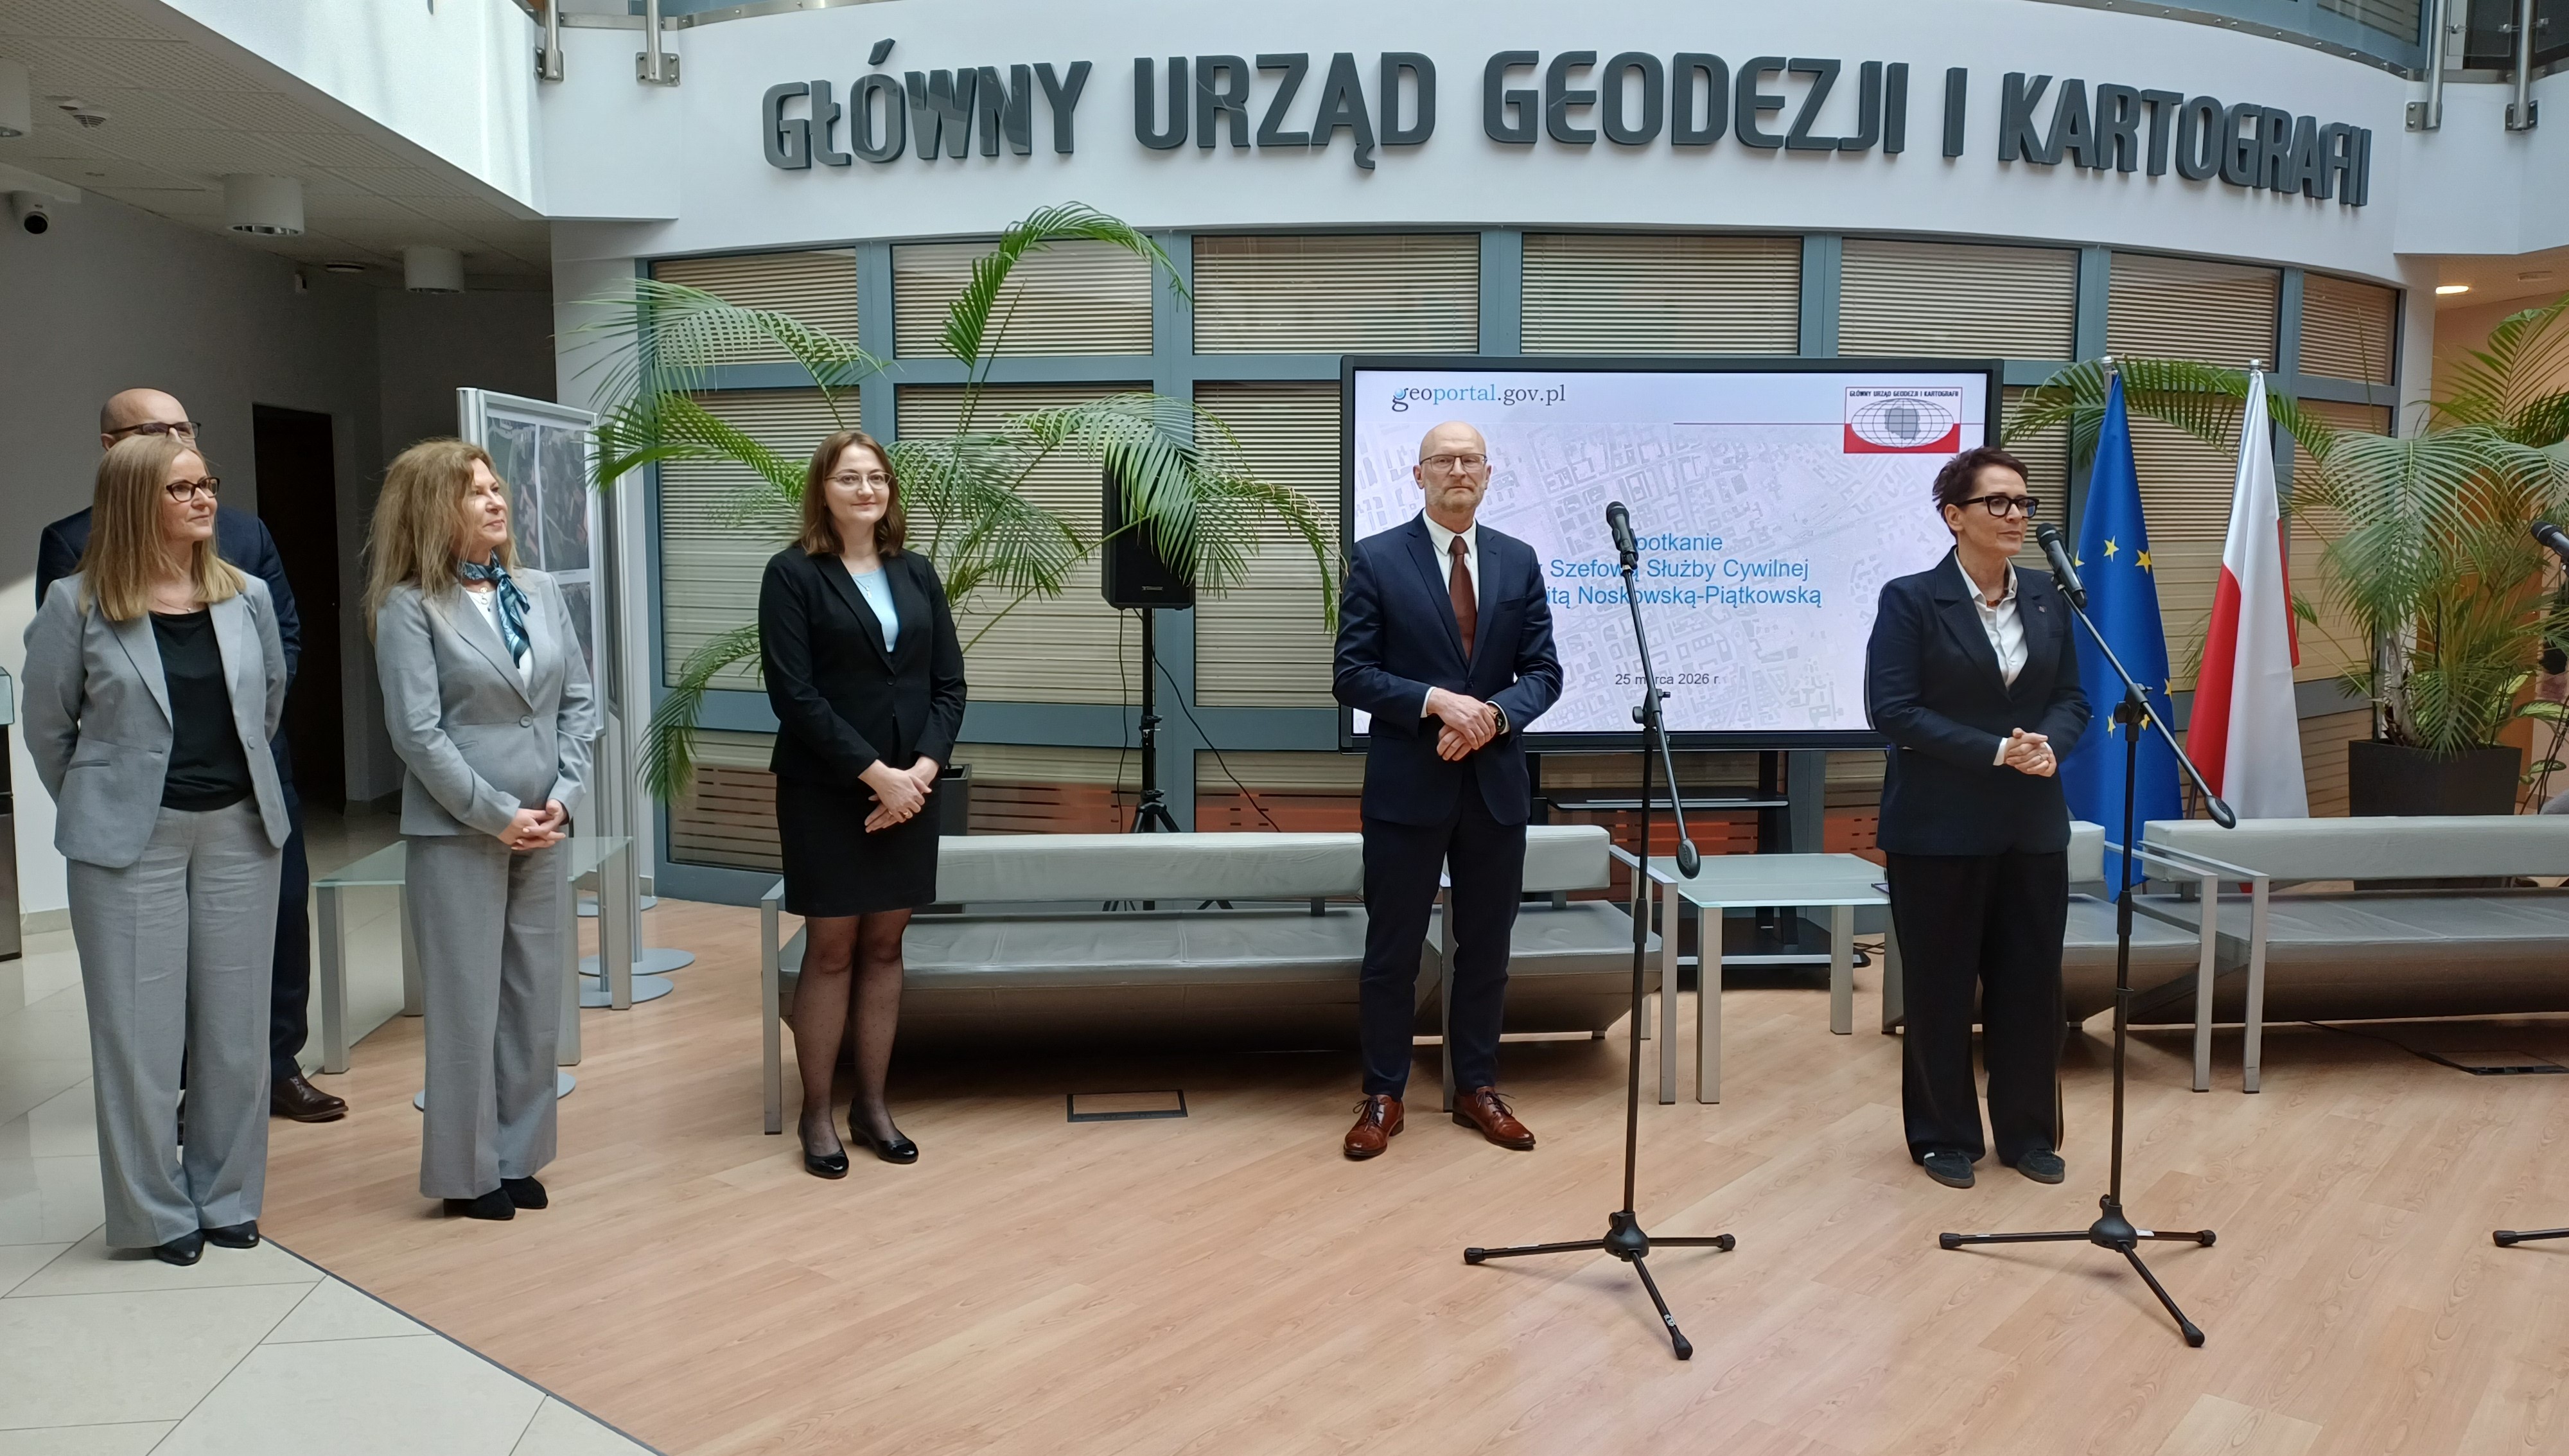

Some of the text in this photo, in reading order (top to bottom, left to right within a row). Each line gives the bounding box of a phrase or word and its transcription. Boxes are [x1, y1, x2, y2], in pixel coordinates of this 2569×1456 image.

[762, 37, 2373, 207] GŁÓWNY URZĄD GEODEZJI I KARTOGRAFII
[1392, 384, 1566, 412] geoportal.gov.pl
[1636, 533, 1723, 552] potkanie
[1647, 559, 1716, 582] Służby
[1724, 559, 1809, 582] Cywilnej
[1547, 585, 1822, 609] itą Noskowską-Piątkowską
[1615, 674, 1631, 685] 25
[1635, 676, 1674, 685] mrca
[1678, 674, 1709, 685] 2026
